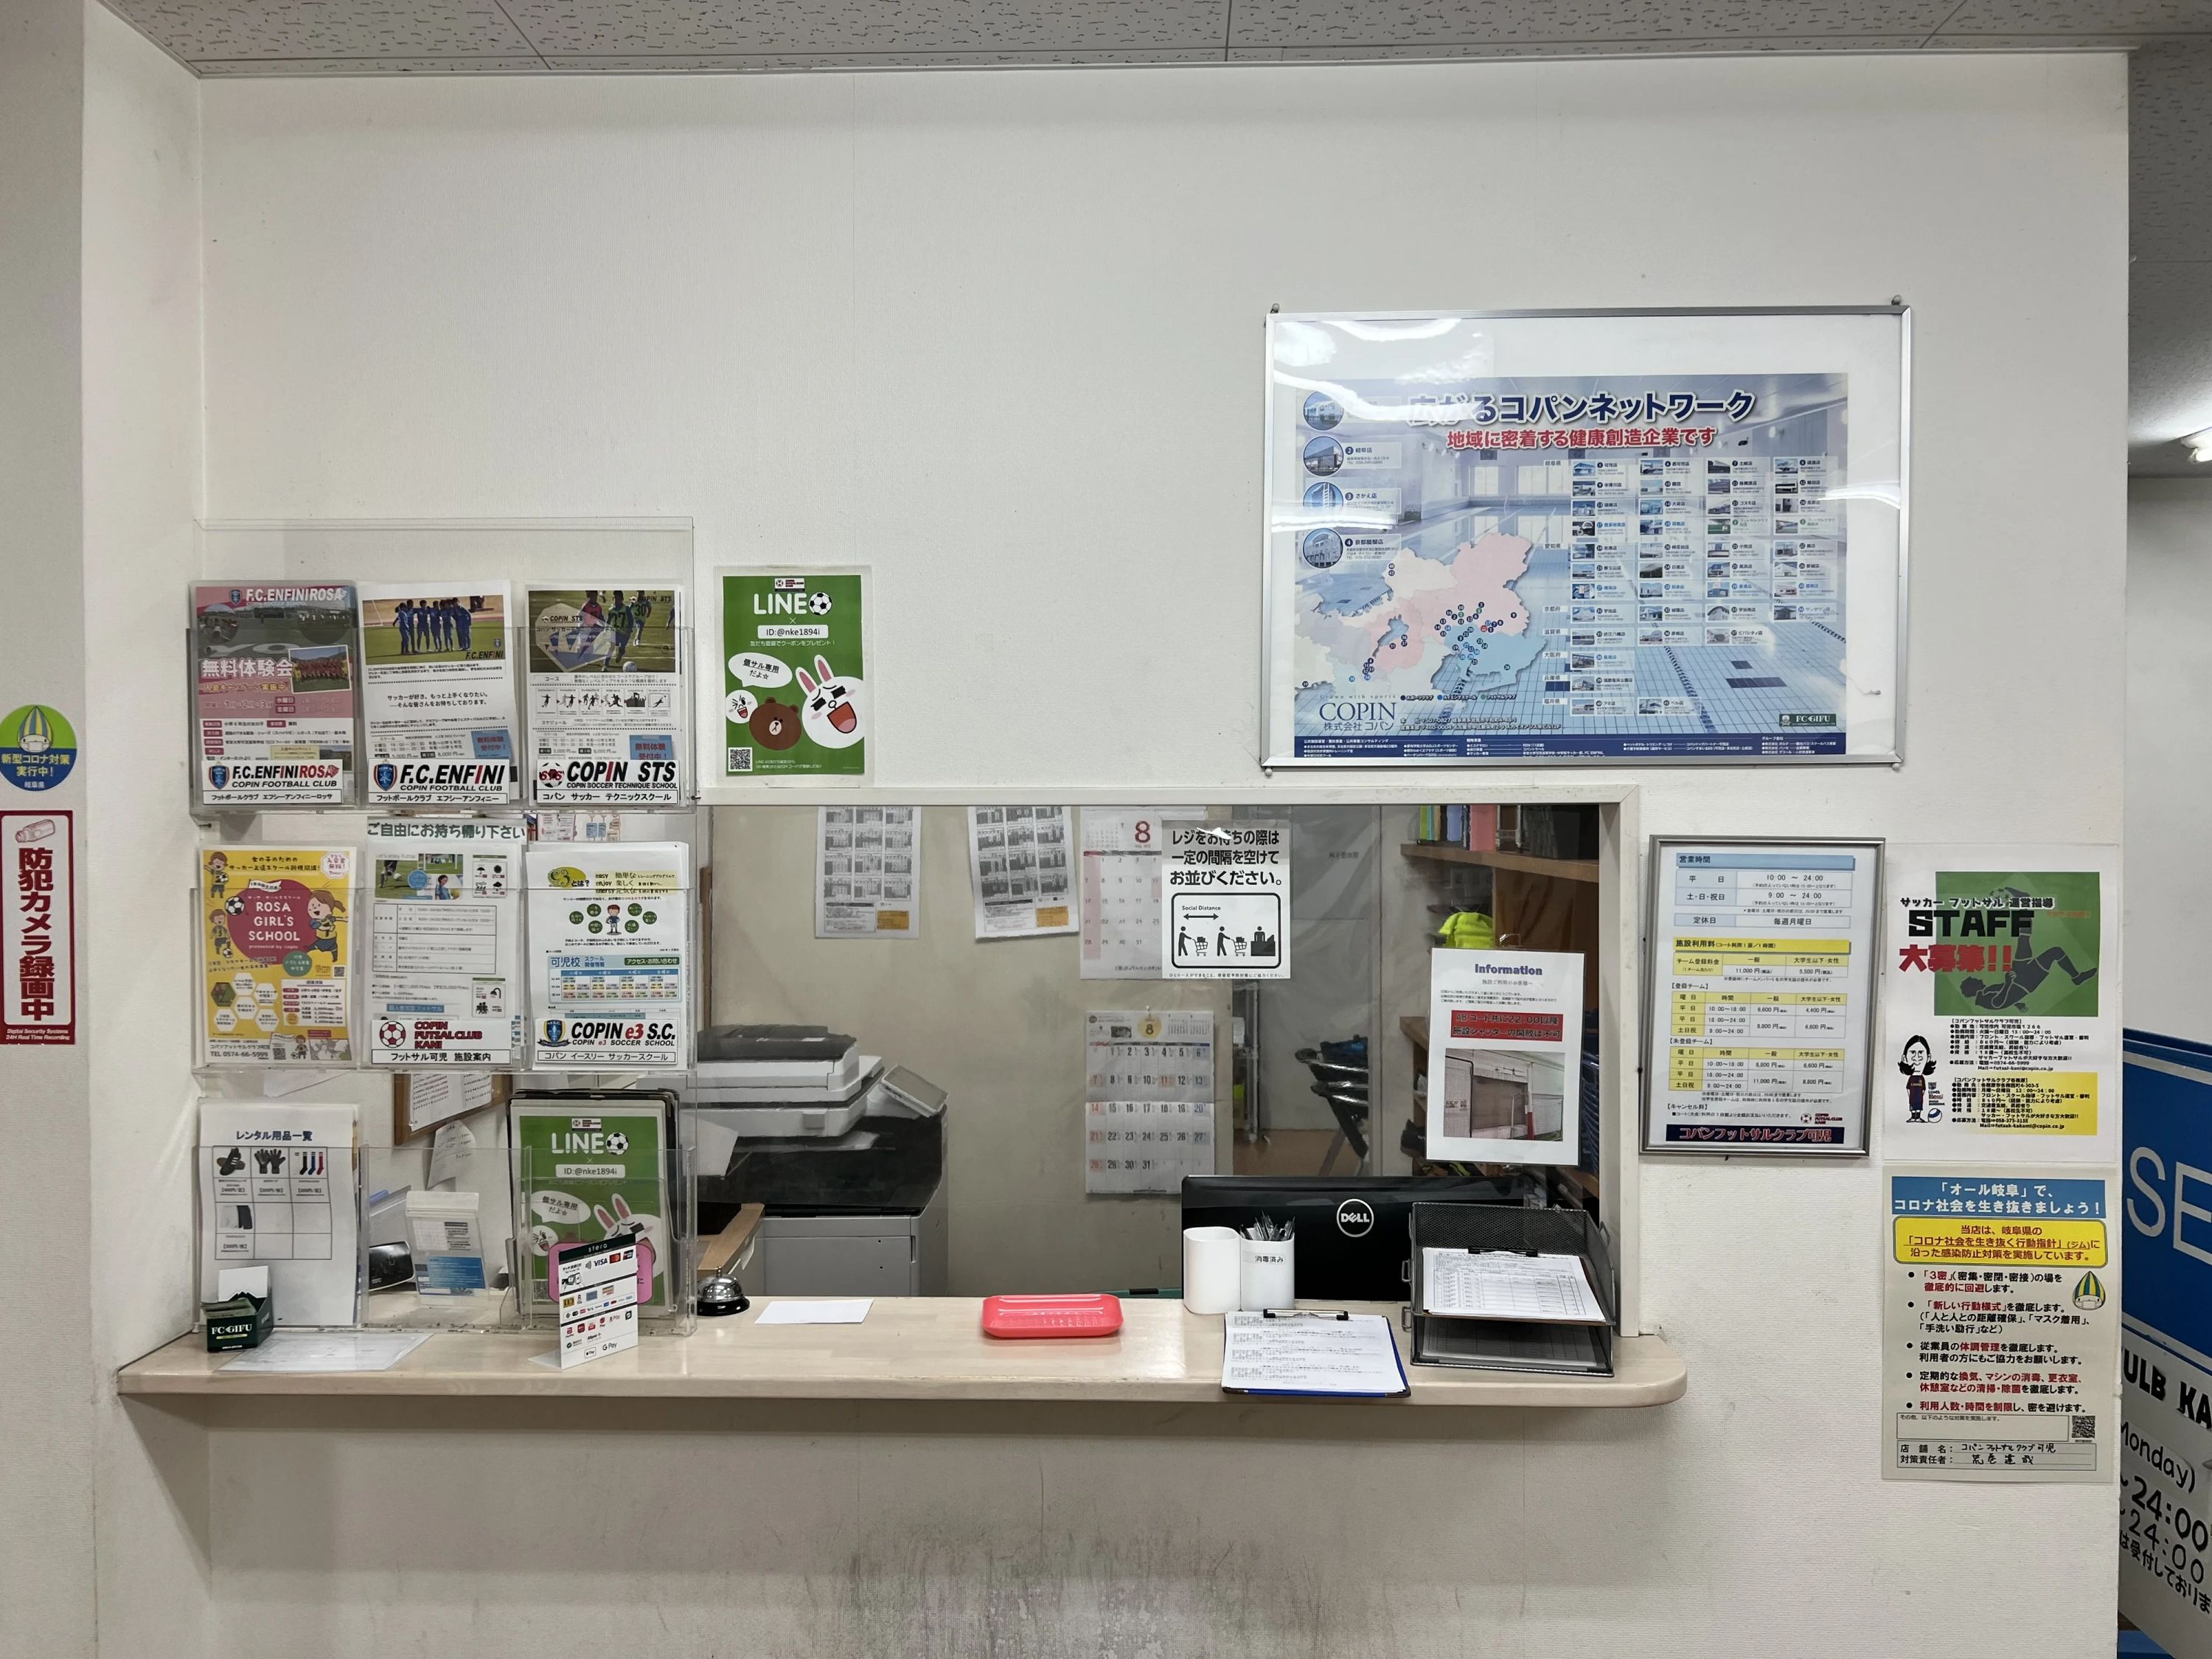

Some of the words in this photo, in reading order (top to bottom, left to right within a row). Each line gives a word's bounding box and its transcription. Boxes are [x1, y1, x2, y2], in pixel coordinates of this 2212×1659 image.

[1447, 427, 1717, 450] 地域に密着する健康創造企業です
[754, 593, 807, 615] LINE
[766, 628, 820, 636] ID:@nke1894i
[466, 651, 504, 660] F.C.ENFINI
[202, 658, 294, 679] 無料体験会
[1319, 702, 1396, 721] COPIN
[1324, 722, 1363, 731] 株式会社
[1365, 722, 1394, 731] コパン
[1, 754, 70, 765] 新型コロナ対策
[16, 766, 53, 776] 実行中！
[400, 764, 506, 785] F.C.ENFINI
[567, 761, 627, 782] COPIN
[638, 761, 676, 782] STS
[366, 823, 525, 840] ご自由にお持ち帰り下さい
[1135, 820, 1150, 844] 8
[1172, 849, 1279, 865] 一定の間隔を空けて
[1679, 855, 1711, 863] 営業時間
[1170, 870, 1281, 886] お並びください。
[256, 902, 291, 912] ROSA
[1899, 898, 1944, 908] サッカー
[1949, 898, 2003, 908] フットサル
[254, 915, 294, 926] GIRL'S
[1773, 917, 1812, 926] 毎週月曜日
[1909, 910, 2034, 936] STAFF
[17, 846, 55, 1022] 防犯カメラ録画中
[248, 931, 300, 941] SCHOOL
[551, 956, 580, 967] 可児校
[1475, 964, 1543, 976] Information
[414, 1021, 448, 1031] COPIN
[571, 1022, 623, 1039] COPIN
[625, 1023, 644, 1040] e3
[647, 1022, 676, 1040] S.C.
[1146, 1024, 1154, 1035] 8
[414, 1040, 443, 1049] KANI
[391, 1052, 448, 1062] フットサル可児
[454, 1052, 491, 1062] 施設案内
[608, 1053, 668, 1061] サッカースクール
[1110, 1047, 1115, 1056] 1
[1127, 1047, 1132, 1056] 2
[1144, 1047, 1150, 1056] 3
[1162, 1047, 1166, 1056] 4
[1179, 1047, 1183, 1056] 5
[1144, 1076, 1151, 1085] 10
[236, 1130, 313, 1141] レンタル用品一覧
[1107, 1132, 1116, 1141] 22
[1125, 1132, 1134, 1141] 23
[1142, 1132, 1151, 1141] 24
[1160, 1132, 1169, 1141] 25
[552, 1132, 605, 1155] LINE
[563, 1167, 618, 1175] ID:@nke1894i
[1940, 1182, 2053, 1197] 「オール岐阜」で、
[1894, 1199, 2100, 1215] コロナ社会を生き抜きましょう！
[1340, 1212, 1370, 1223] DELL
[1961, 1225, 2042, 1235] 当店は、岐阜県の
[1910, 1248, 2090, 1261] 沿った感染防止対策を実施しています。
[594, 1258, 608, 1266] VISA
[1924, 1282, 2014, 1293] 徹底的に回避します。
[1927, 1301, 2065, 1312] 「新しい行動様式」を徹底します。
[1920, 1341, 2059, 1353] 従業員の体調管理を徹底します。
[1919, 1353, 2082, 1365] 利用者の方にもご協力をお願いします。
[1919, 1371, 2082, 1383] 定期的な換気、マシンの消毒、更衣室、
[2121, 1347, 2166, 1402] ULB
[1920, 1384, 2079, 1394] 休憩室などの清掃・除菌を徹底します。
[1920, 1401, 2087, 1413] 利用人数・時間を制限し、密を避けます。
